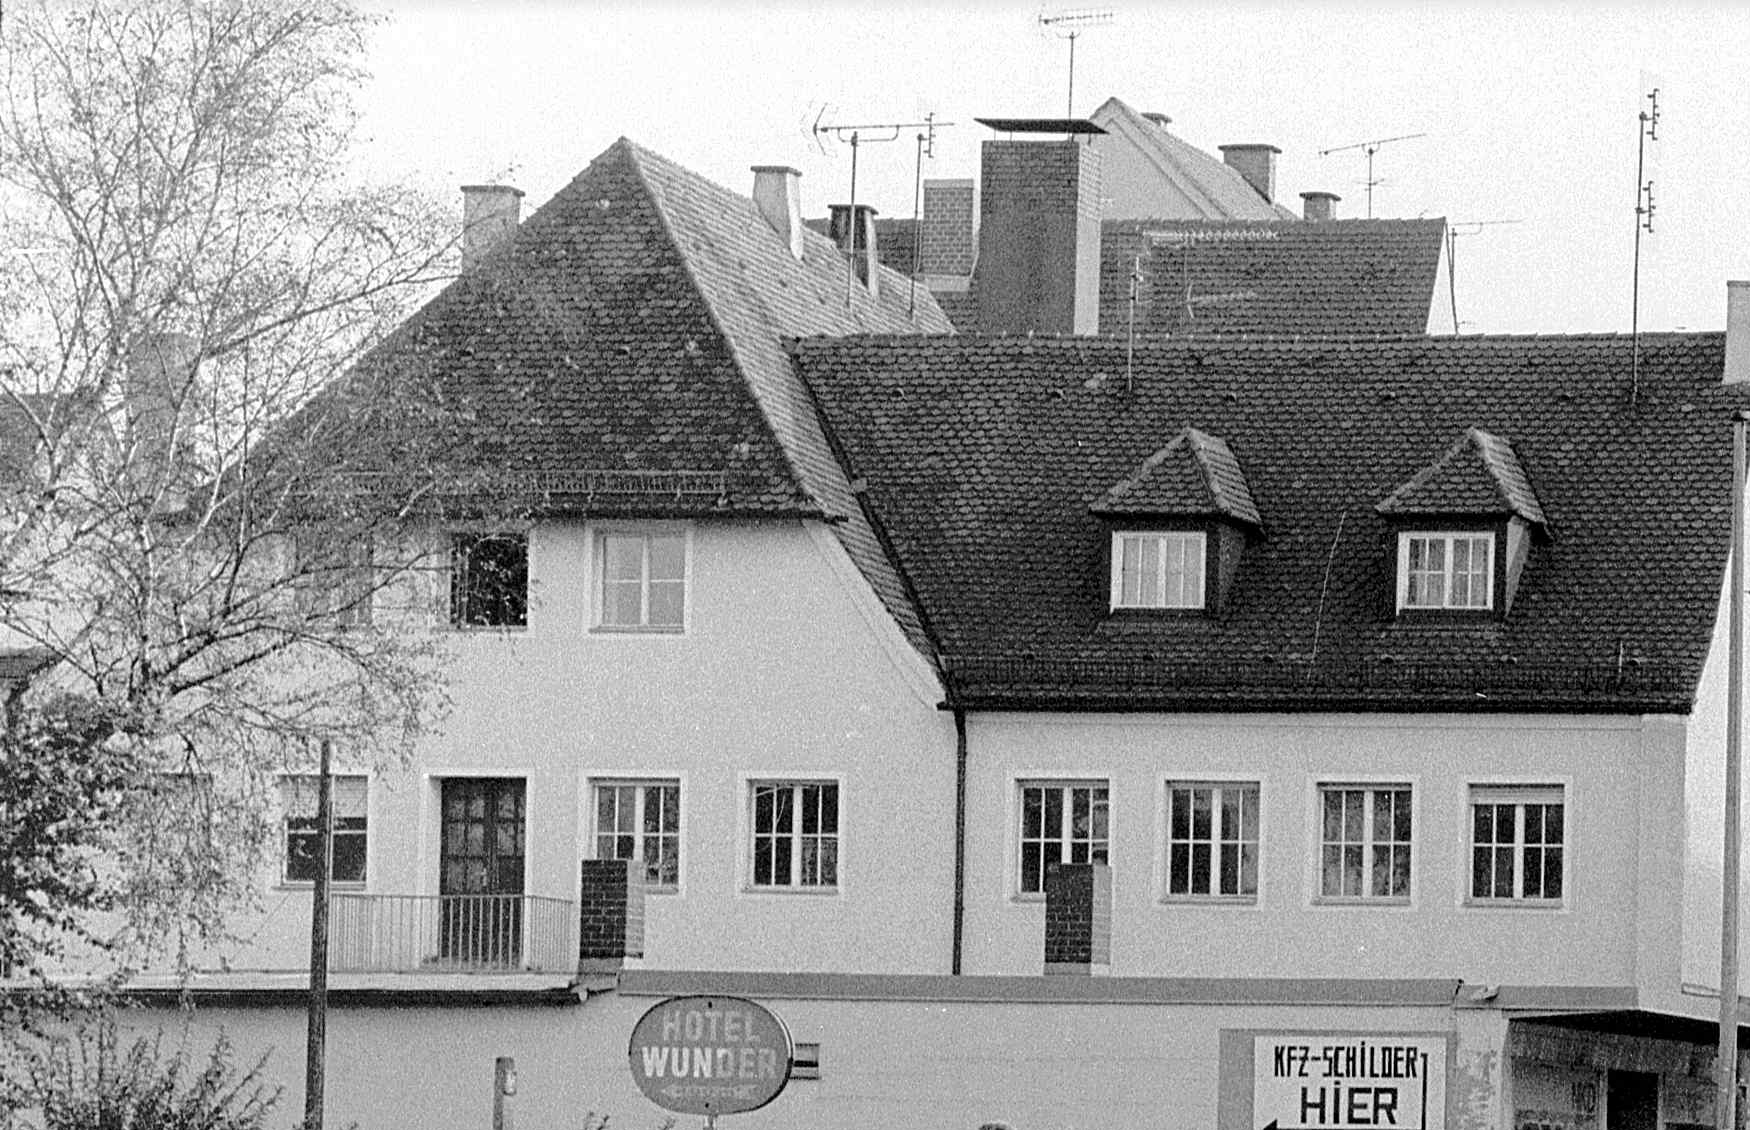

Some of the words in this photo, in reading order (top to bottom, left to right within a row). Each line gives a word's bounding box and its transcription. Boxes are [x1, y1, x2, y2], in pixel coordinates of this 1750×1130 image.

[663, 1009, 761, 1042] HOTEL
[640, 1045, 778, 1079] WUNDER
[1274, 1041, 1418, 1078] KFZ-SCHILDER
[1300, 1080, 1399, 1125] HIER
